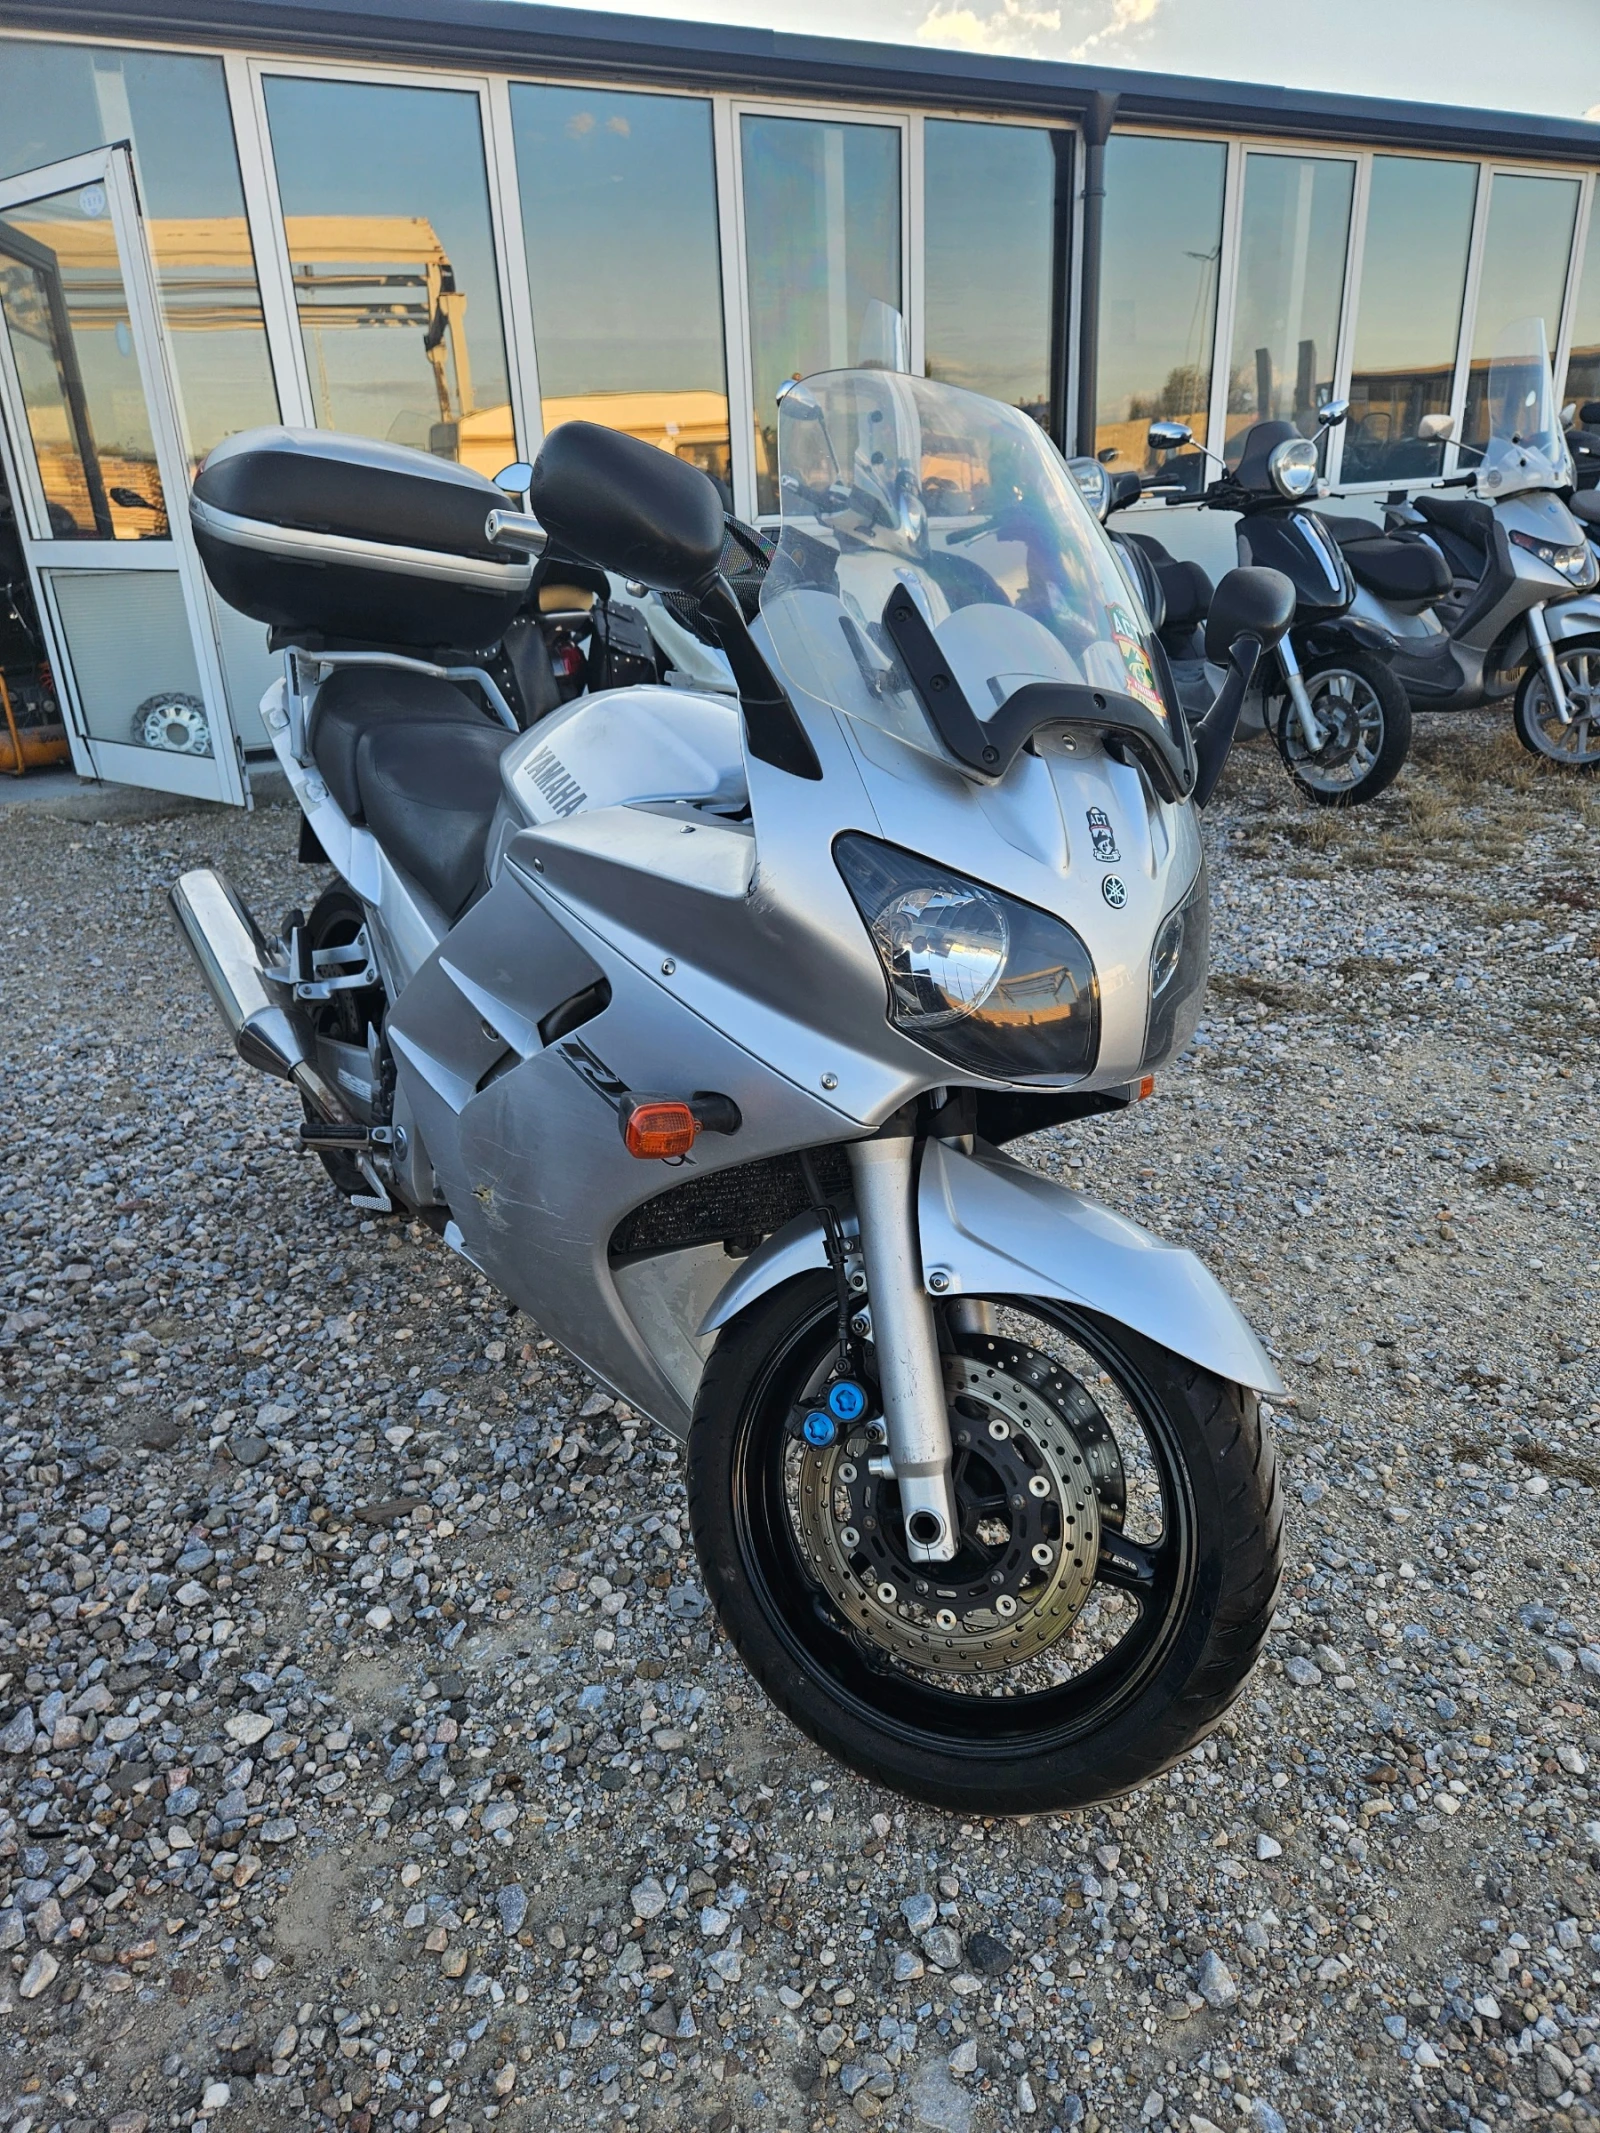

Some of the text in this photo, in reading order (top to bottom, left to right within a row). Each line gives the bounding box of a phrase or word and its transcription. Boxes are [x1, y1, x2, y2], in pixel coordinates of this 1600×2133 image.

[1112, 612, 1144, 646] ACT
[524, 745, 588, 819] YAMAHA
[1090, 814, 1108, 826] ACT
